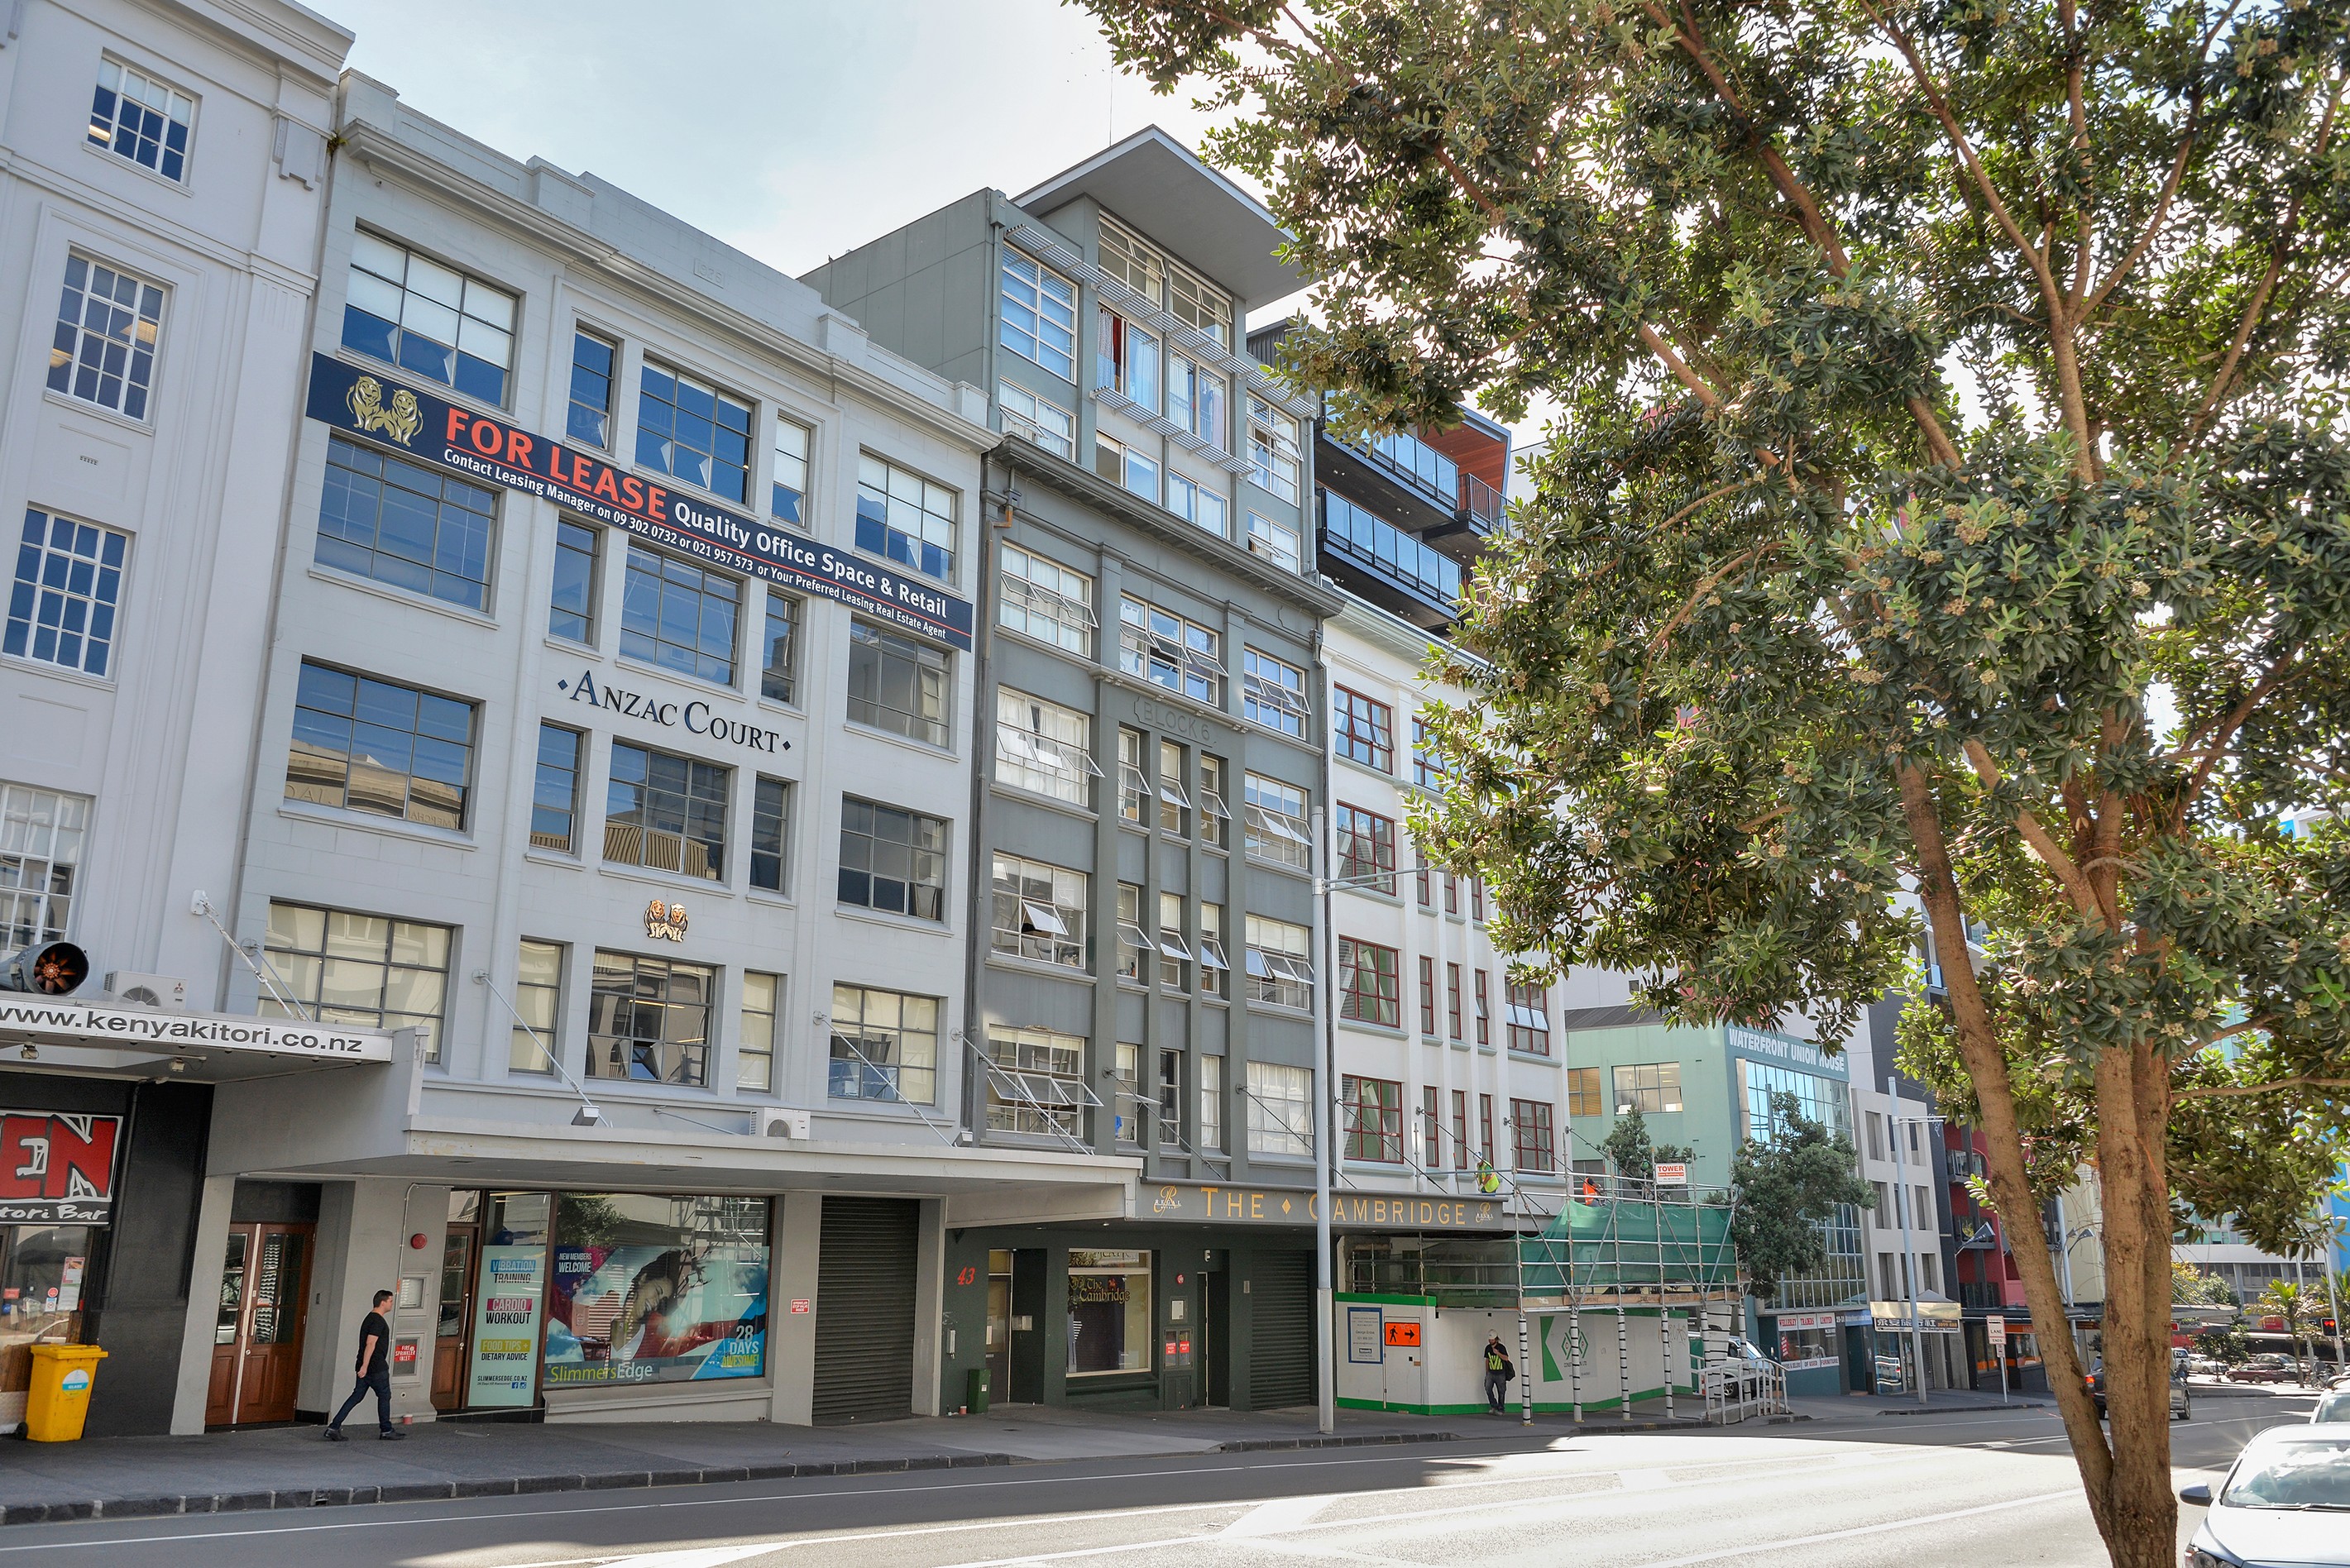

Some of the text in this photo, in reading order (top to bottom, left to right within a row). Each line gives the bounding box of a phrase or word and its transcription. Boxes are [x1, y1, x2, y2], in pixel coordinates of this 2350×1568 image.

[447, 407, 947, 619] FOR LEASE Quality Office Space & Retail
[443, 448, 946, 639] Contact Leasing Manager on 09 302 0732 or 021 957 573 or Your Preferred Leasing Real Estate Agent
[1144, 701, 1210, 741] BLOCK 6
[0, 1006, 362, 1053] www.kenyakitori.co.nz
[1729, 1028, 1788, 1059] WATERFRONT
[1791, 1044, 1816, 1066] UNION
[57, 1204, 108, 1221] Bar
[1200, 1186, 1466, 1225] THE CAMBRIDGE
[571, 1252, 592, 1260] MEMBERS
[492, 1260, 535, 1271] VIBRATION
[558, 1261, 591, 1273] WELCOME
[494, 1274, 531, 1284] TRAINING
[957, 1266, 976, 1285] 43
[1086, 1277, 1103, 1290] The
[1079, 1288, 1131, 1304] Cambridge
[492, 1298, 527, 1311] CARDIO
[486, 1312, 531, 1324] WORKOUT
[735, 1325, 754, 1342] 28
[482, 1341, 503, 1350] FOOD
[505, 1341, 522, 1350] TIPS
[730, 1341, 759, 1355] DAYS
[481, 1352, 528, 1361] DIETARY ADVICE
[722, 1354, 759, 1366] AWESOME!
[550, 1361, 653, 1383] SlimmersEdge
